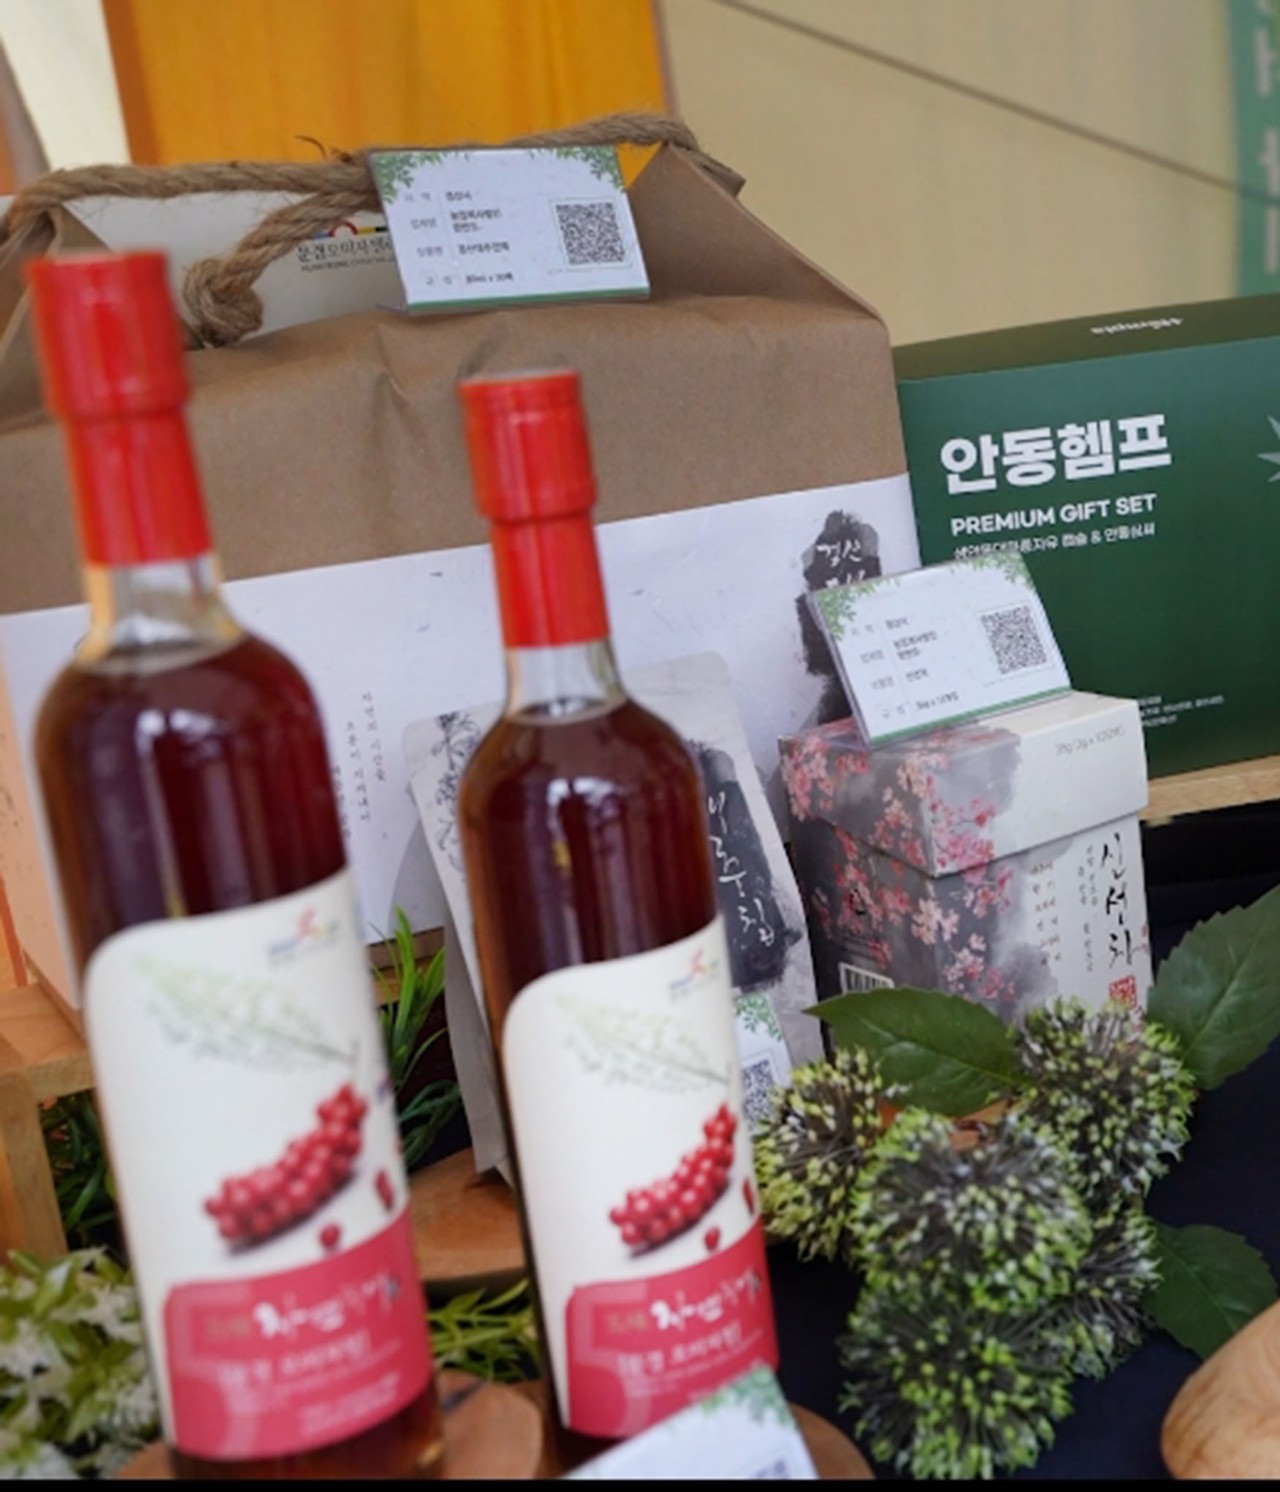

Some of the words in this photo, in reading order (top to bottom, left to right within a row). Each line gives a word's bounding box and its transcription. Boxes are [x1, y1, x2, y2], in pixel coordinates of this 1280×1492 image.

[940, 414, 1172, 495] 안동헴프
[951, 505, 1057, 536] PREMIUM
[1059, 498, 1112, 524] GIFT
[1115, 493, 1158, 516] SET
